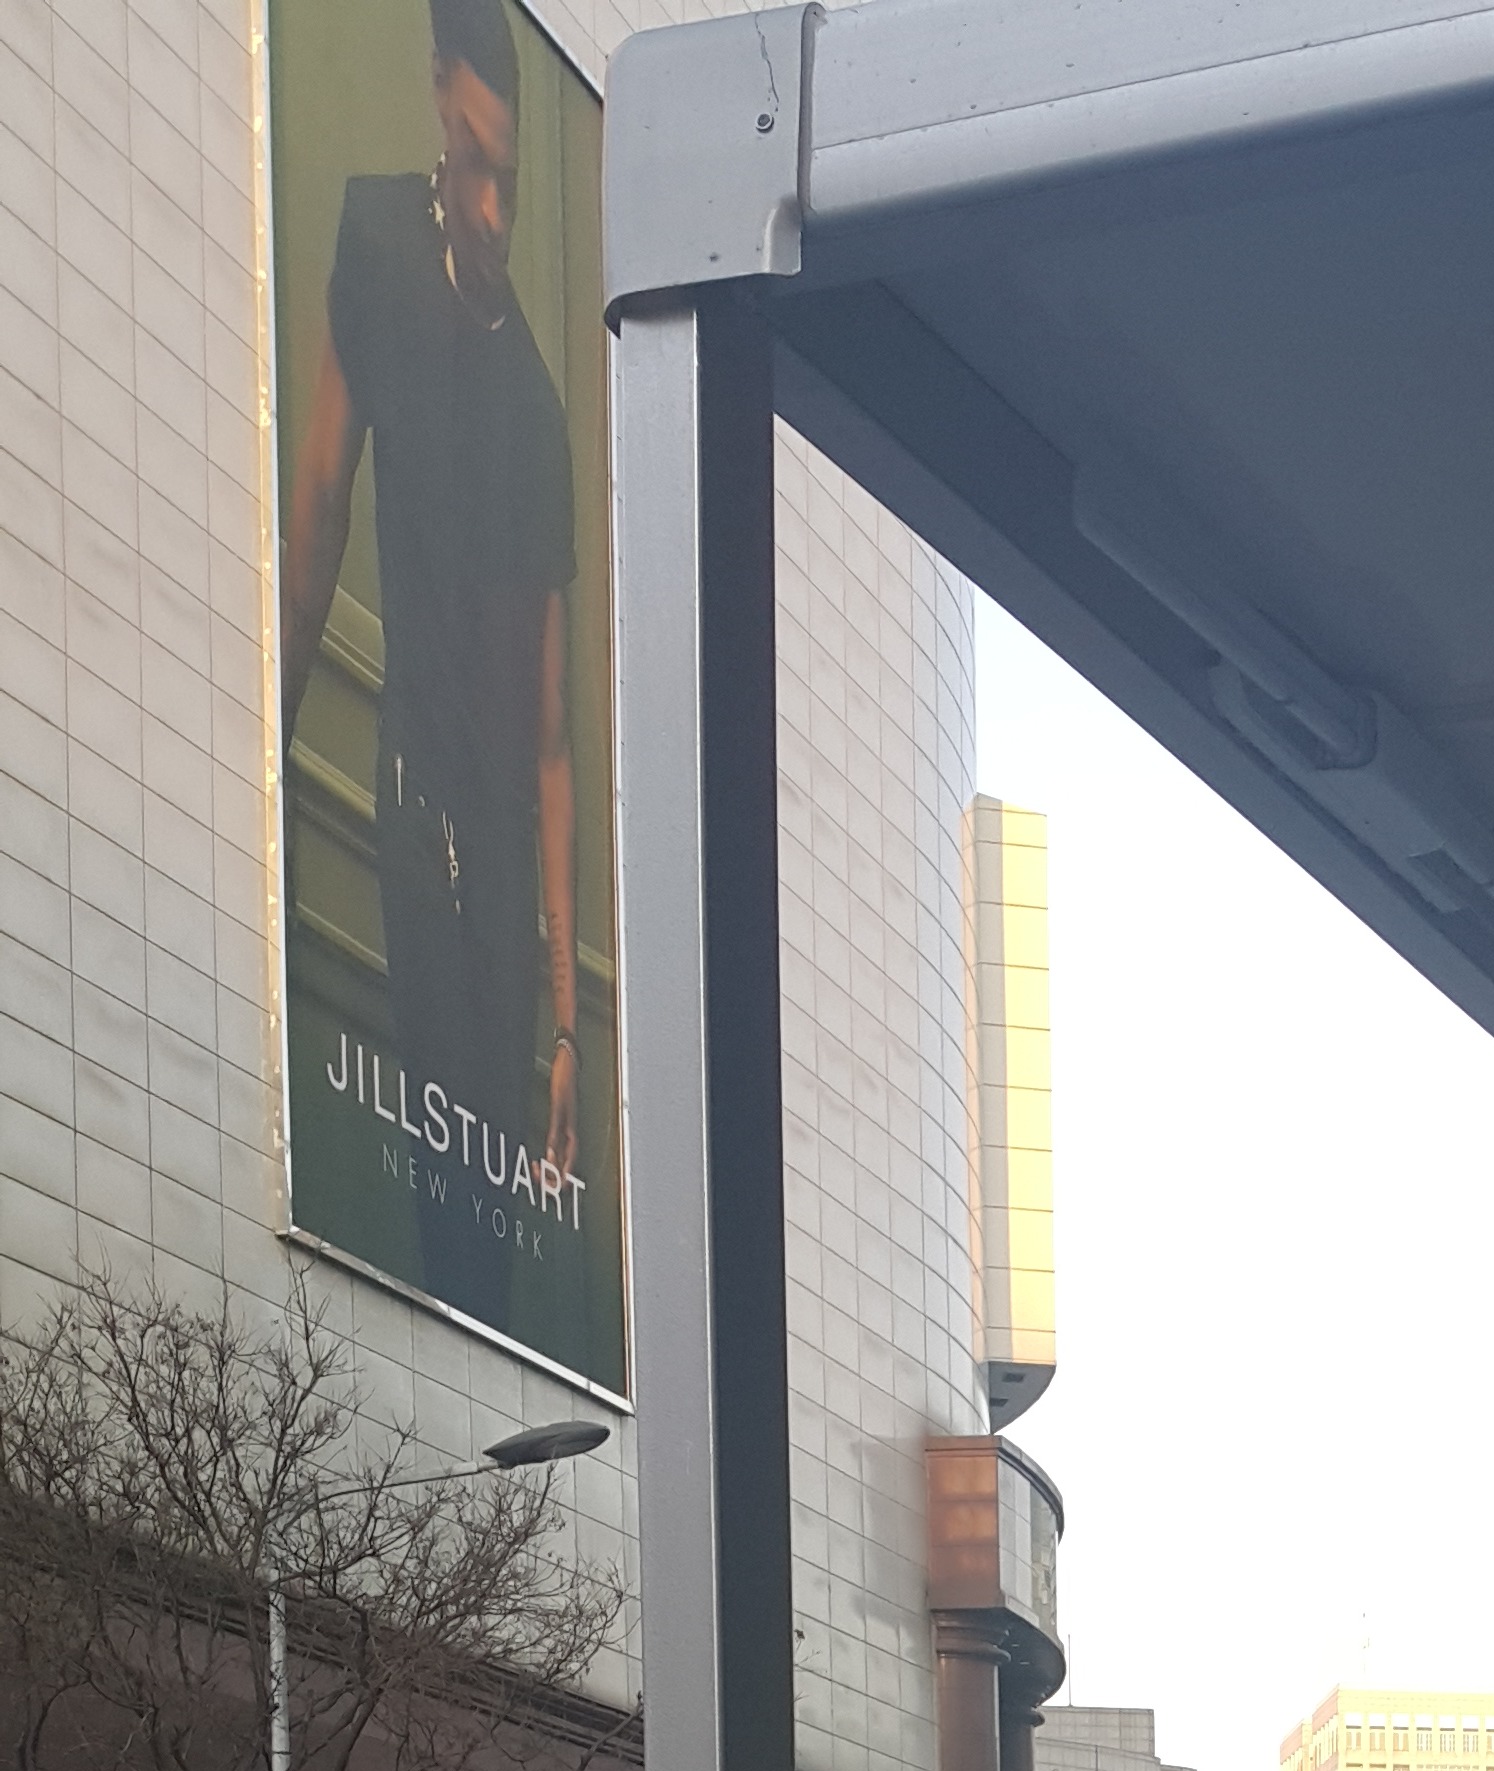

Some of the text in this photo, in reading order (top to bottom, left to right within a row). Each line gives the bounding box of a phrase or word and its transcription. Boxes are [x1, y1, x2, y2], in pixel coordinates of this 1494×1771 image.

[326, 1032, 586, 1230] JILLSTUART
[382, 1143, 543, 1261] NEW YORK
